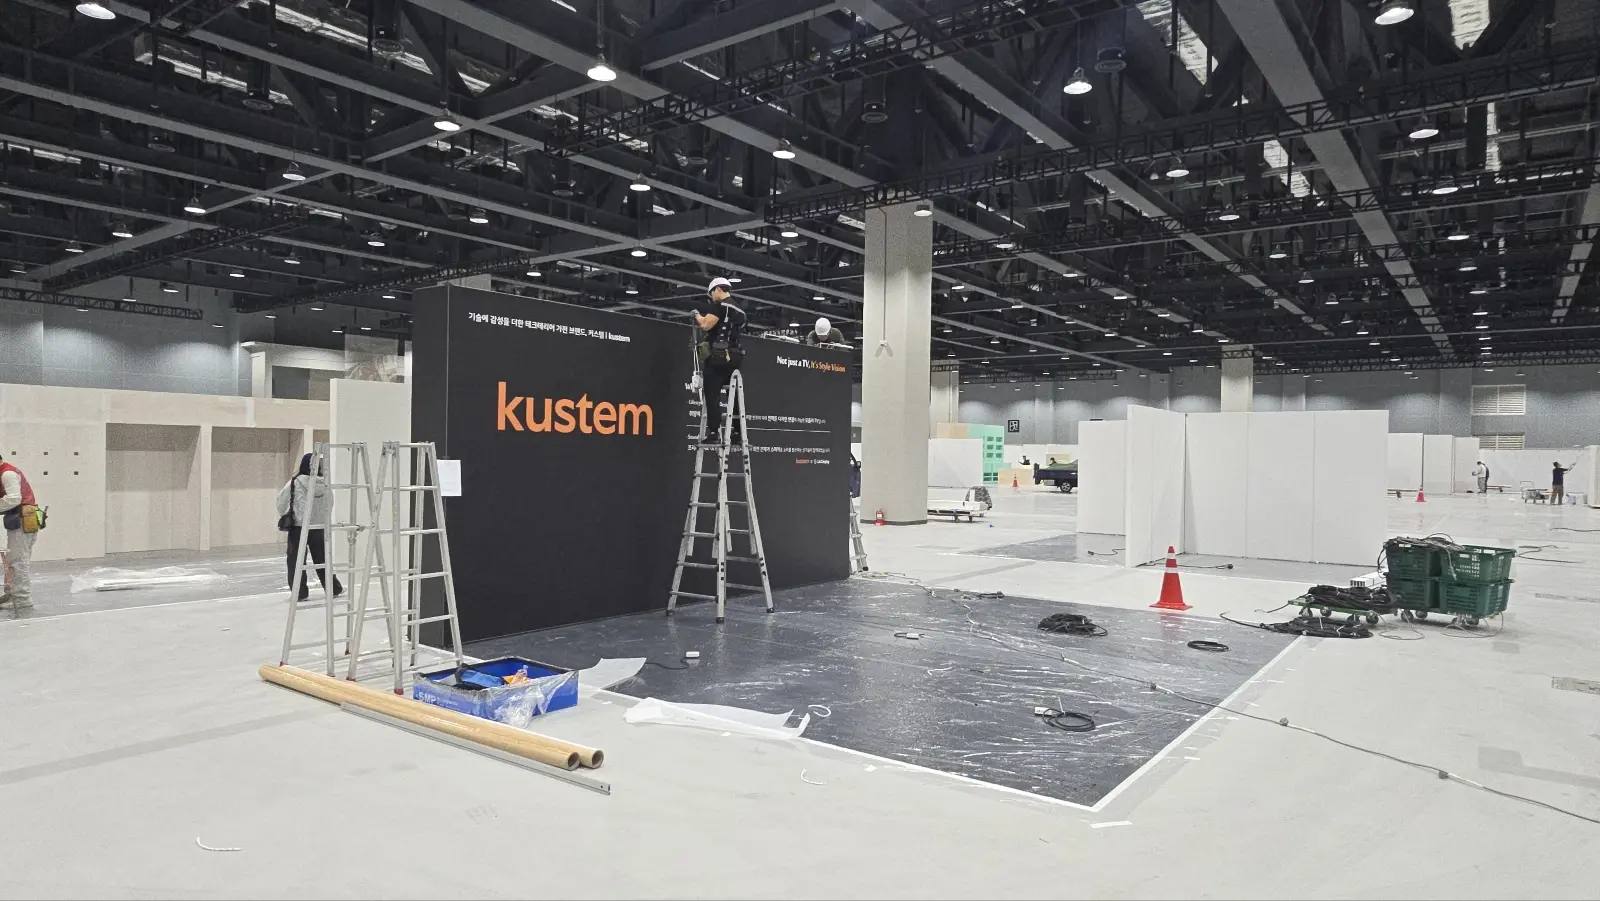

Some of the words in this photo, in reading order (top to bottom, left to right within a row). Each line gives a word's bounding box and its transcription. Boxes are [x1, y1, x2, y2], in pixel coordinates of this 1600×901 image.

[468, 312, 489, 323] 기술에
[490, 315, 510, 327] 감성을
[511, 318, 524, 328] 더한
[556, 324, 568, 334] 가전
[608, 332, 631, 343] kustem
[776, 355, 788, 365] Not
[787, 356, 798, 369] just
[802, 359, 811, 369] TV,
[819, 361, 831, 373] Style
[831, 363, 846, 373] Vision
[497, 381, 653, 436] kustem
